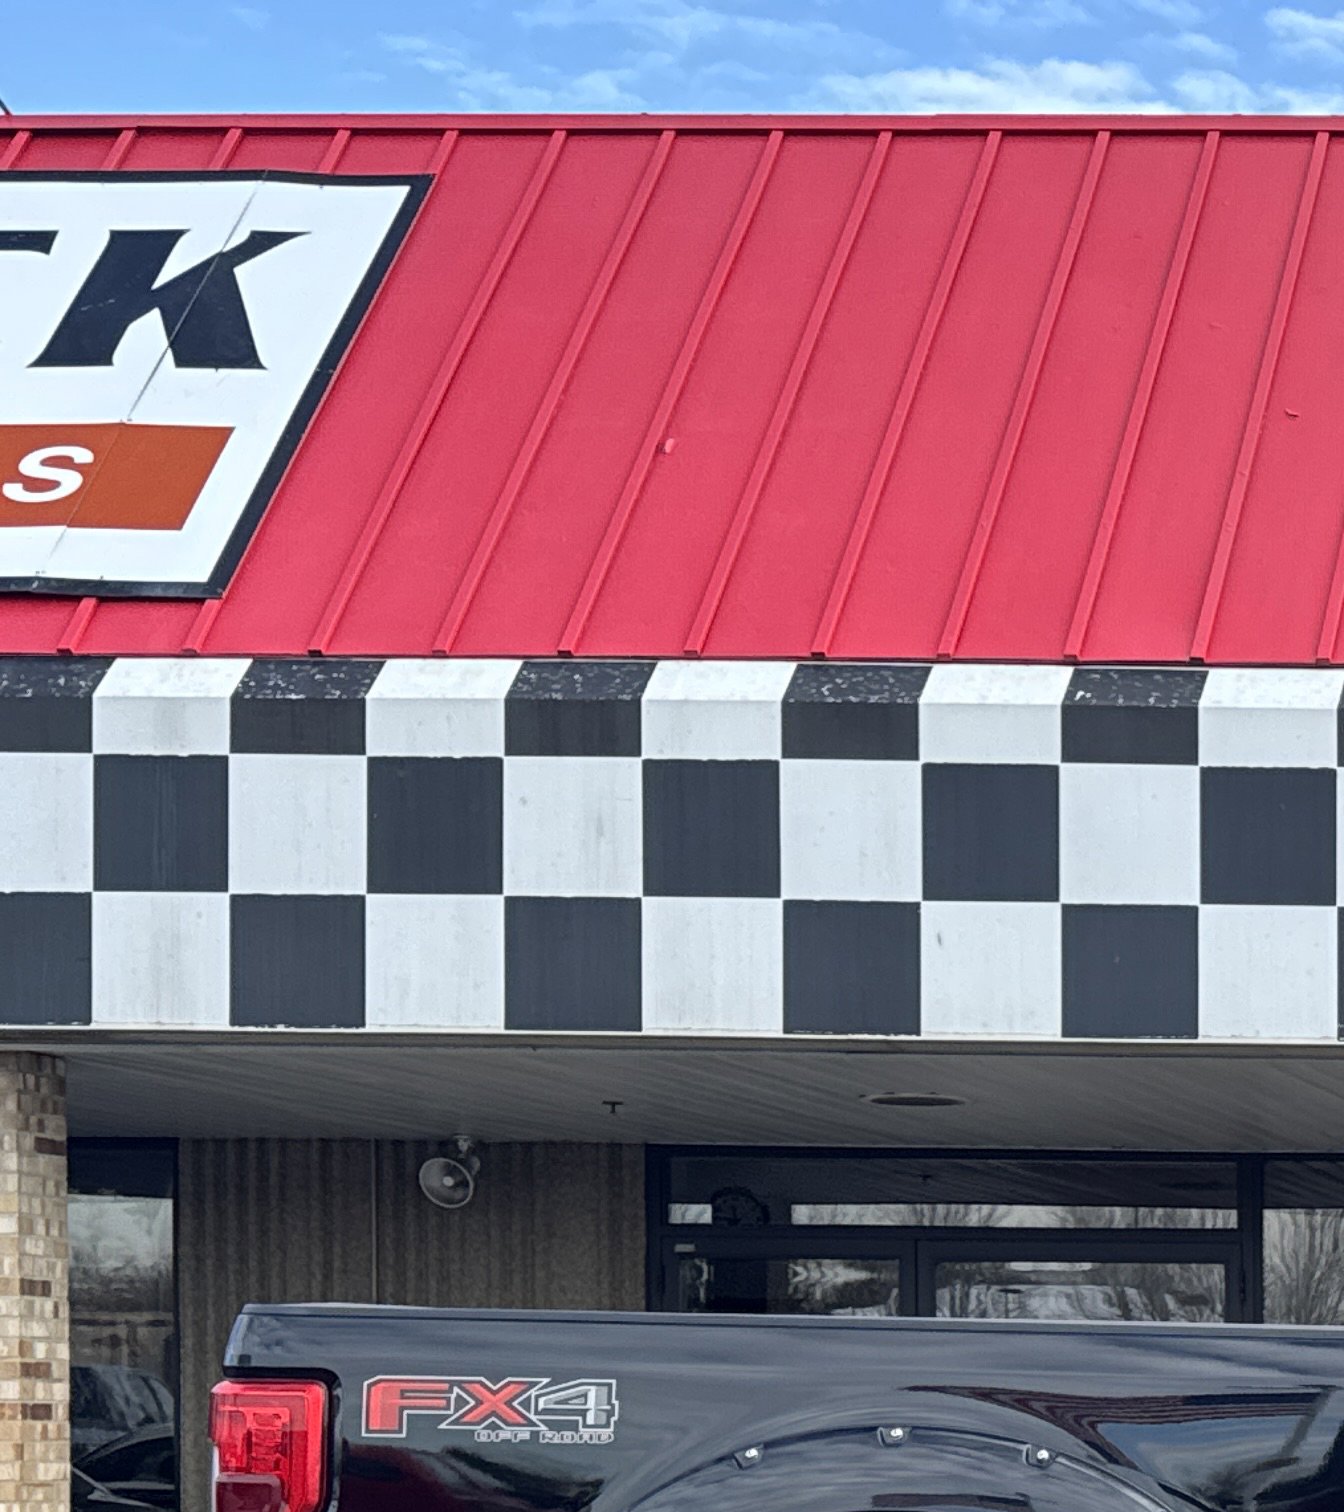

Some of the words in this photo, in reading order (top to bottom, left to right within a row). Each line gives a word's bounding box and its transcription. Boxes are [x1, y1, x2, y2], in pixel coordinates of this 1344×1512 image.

[0, 228, 312, 371] K
[362, 1375, 619, 1438] FX4
[474, 1430, 531, 1443] OFF
[539, 1431, 615, 1444] ROAD
